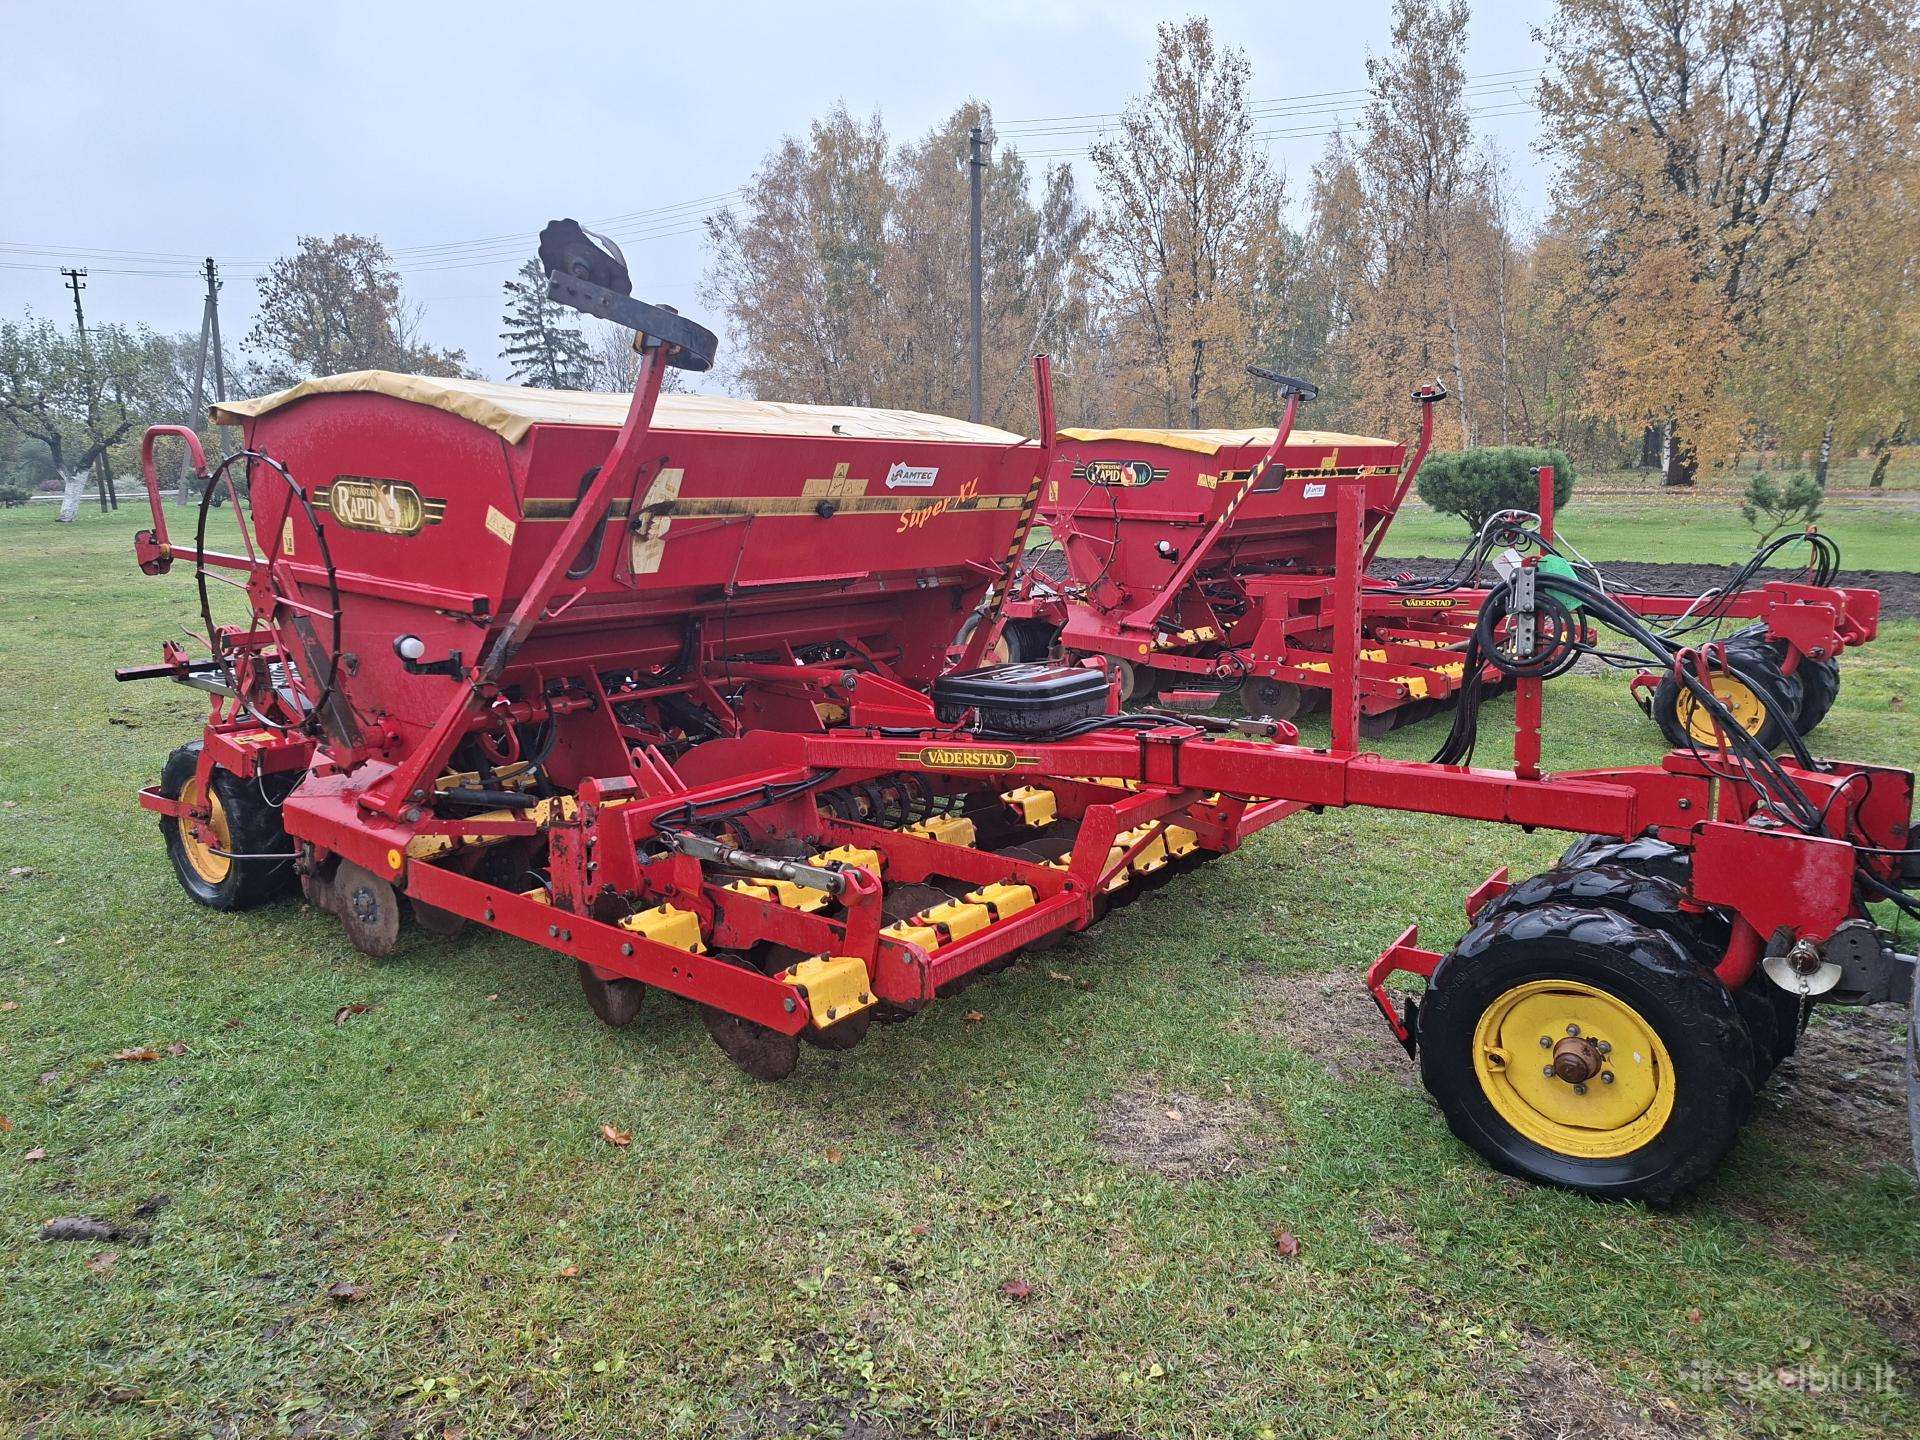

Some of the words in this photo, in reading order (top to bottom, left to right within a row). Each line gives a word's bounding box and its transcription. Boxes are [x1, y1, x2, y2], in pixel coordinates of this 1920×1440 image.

[902, 471, 933, 480] AMTEC
[337, 485, 377, 522] RAPID
[896, 496, 952, 533] Super
[954, 475, 979, 508] XL
[928, 749, 1007, 766] VÄDERSTAD
